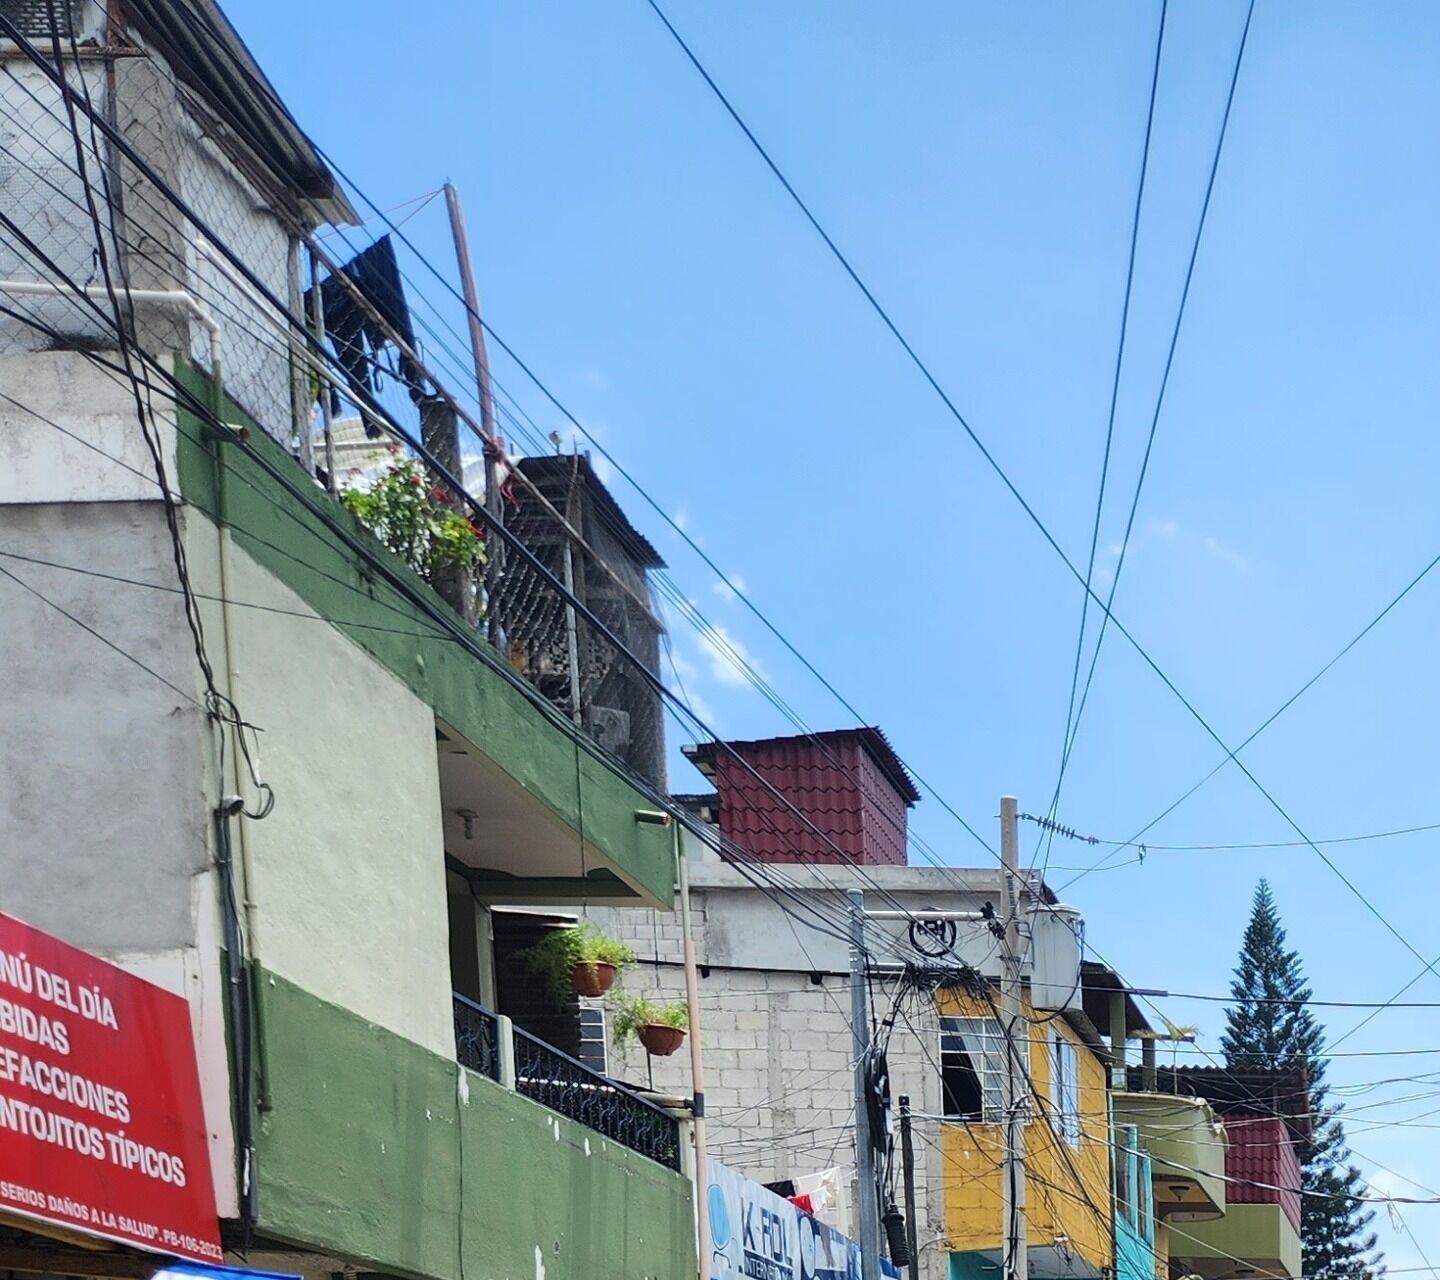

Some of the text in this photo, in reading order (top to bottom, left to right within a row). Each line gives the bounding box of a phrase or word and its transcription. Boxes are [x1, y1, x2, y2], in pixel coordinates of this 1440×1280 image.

[35, 965, 79, 1014] DEL
[79, 985, 119, 1031] DÍA
[105, 1130, 186, 1188] TÍPICOS
[1, 1181, 46, 1209] SERIOS
[47, 1194, 89, 1222] DAÑOS
[91, 1208, 100, 1224] A
[101, 1211, 117, 1229] LA
